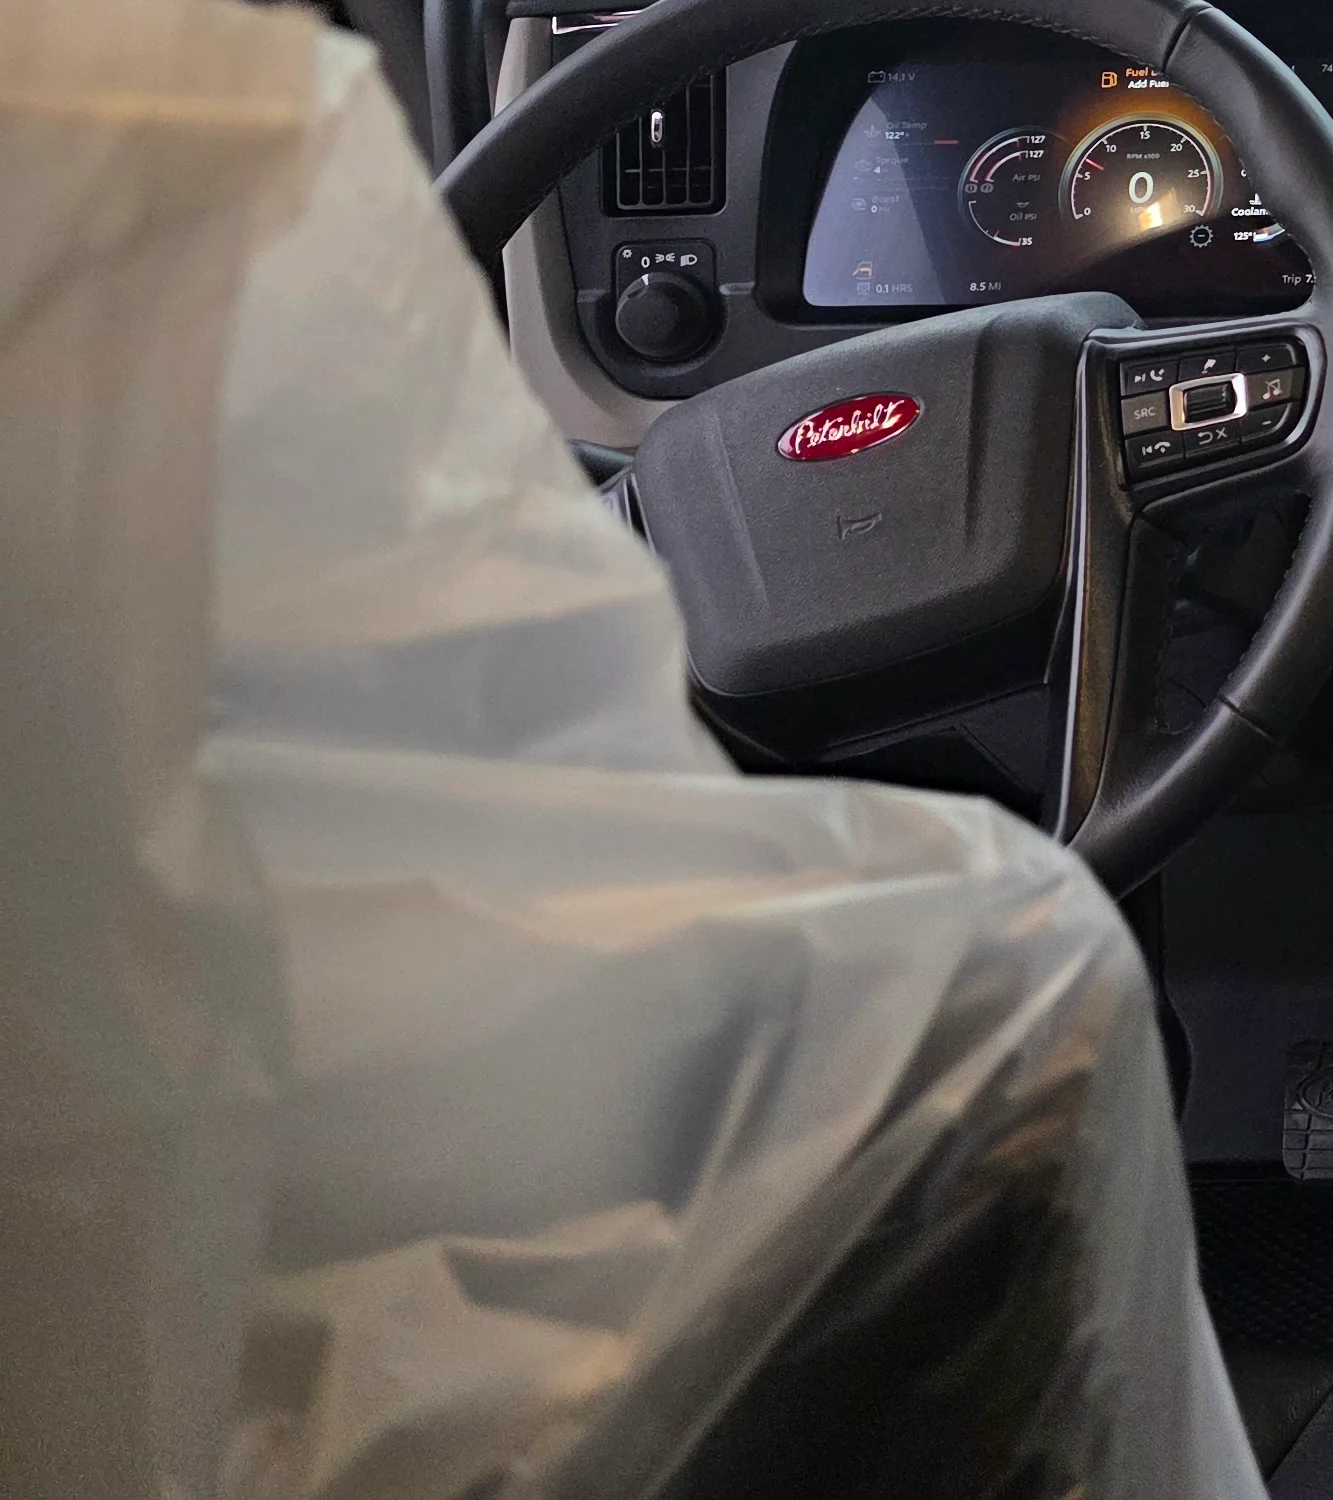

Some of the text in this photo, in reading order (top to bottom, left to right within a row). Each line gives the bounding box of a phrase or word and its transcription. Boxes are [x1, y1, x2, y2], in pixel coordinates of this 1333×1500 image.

[1125, 68, 1149, 78] Fuel
[1321, 63, 1333, 73] 74
[1127, 79, 1148, 89] Add
[1030, 135, 1046, 144] 127
[1140, 130, 1151, 140] 15
[1105, 144, 1117, 153] 10
[1170, 143, 1183, 152] 20
[1029, 150, 1044, 159] 127
[1012, 173, 1025, 182] Air
[1083, 172, 1091, 181] 5
[1187, 169, 1200, 179] 25
[1127, 171, 1155, 205] 0
[1183, 204, 1196, 214] 30
[1231, 207, 1269, 217] Coolan
[1010, 212, 1023, 221] Oil
[1021, 236, 1033, 246] 35
[1281, 274, 1302, 285] Trip
[875, 283, 914, 294] 0.1 HRS
[969, 282, 1002, 292] 8.5 MI
[1133, 406, 1156, 420] SRC
[795, 399, 905, 455] Peterbilt
